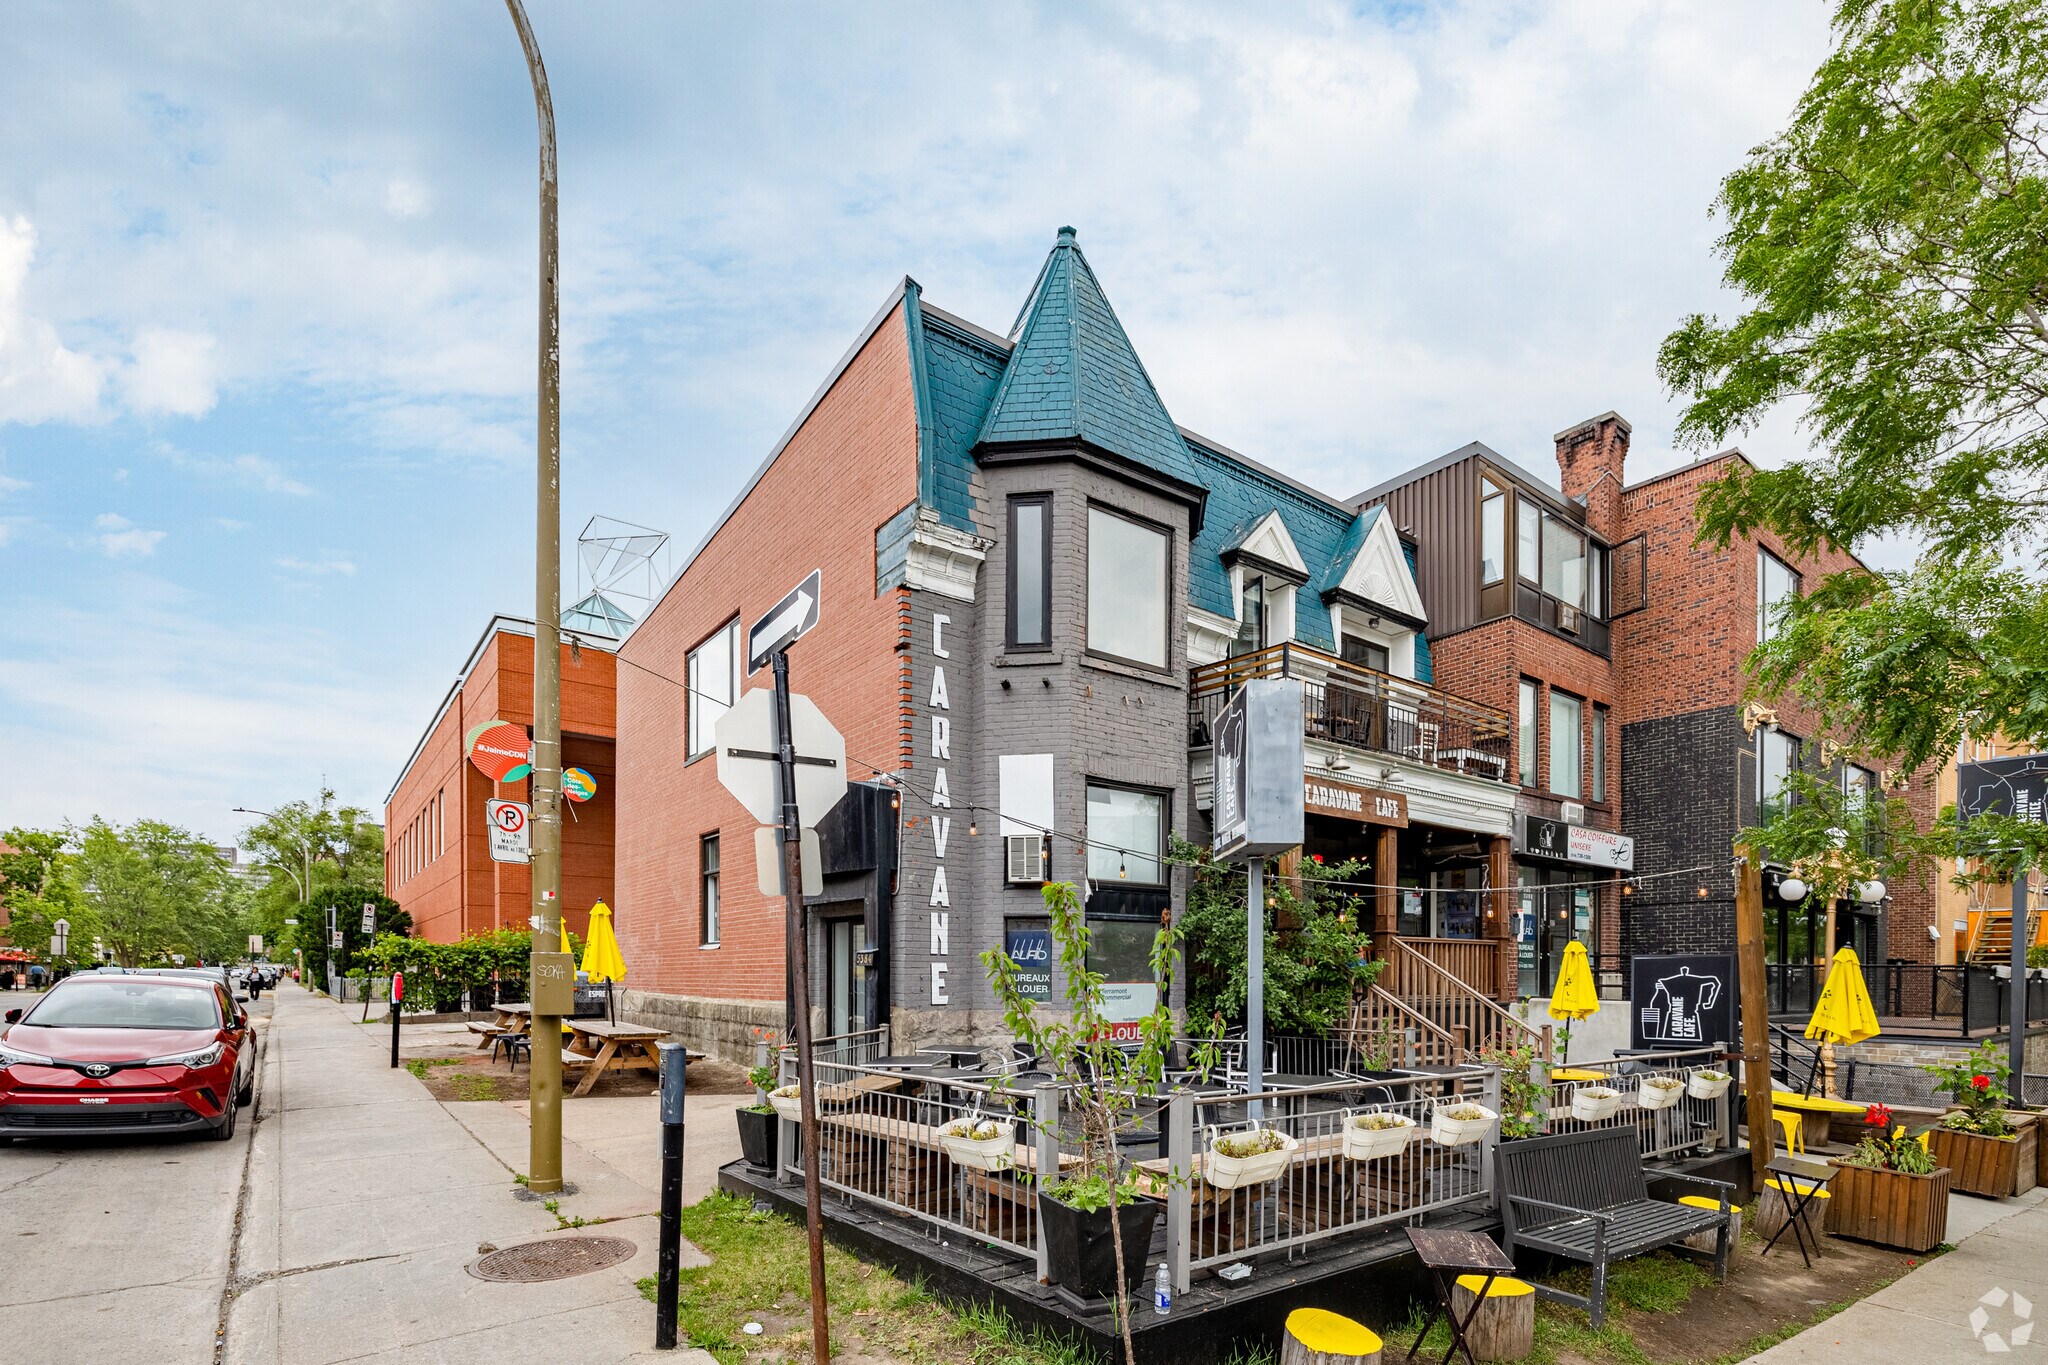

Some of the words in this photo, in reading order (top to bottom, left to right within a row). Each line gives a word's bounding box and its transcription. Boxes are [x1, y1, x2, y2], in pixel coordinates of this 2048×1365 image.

[567, 788, 589, 797] Neiges
[1304, 783, 1363, 813] CARAVANE
[1375, 796, 1400, 819] CAFE
[929, 613, 952, 1006] CARAVANE
[1570, 828, 1587, 840] CASA
[1587, 832, 1618, 846] COIFFURE
[1570, 841, 1592, 852] UNISEXE
[1012, 973, 1050, 983] UREAUX
[1017, 984, 1049, 993] LOUER
[1671, 996, 1684, 1037] CARAVANE
[1109, 1027, 1148, 1041] LOUE
